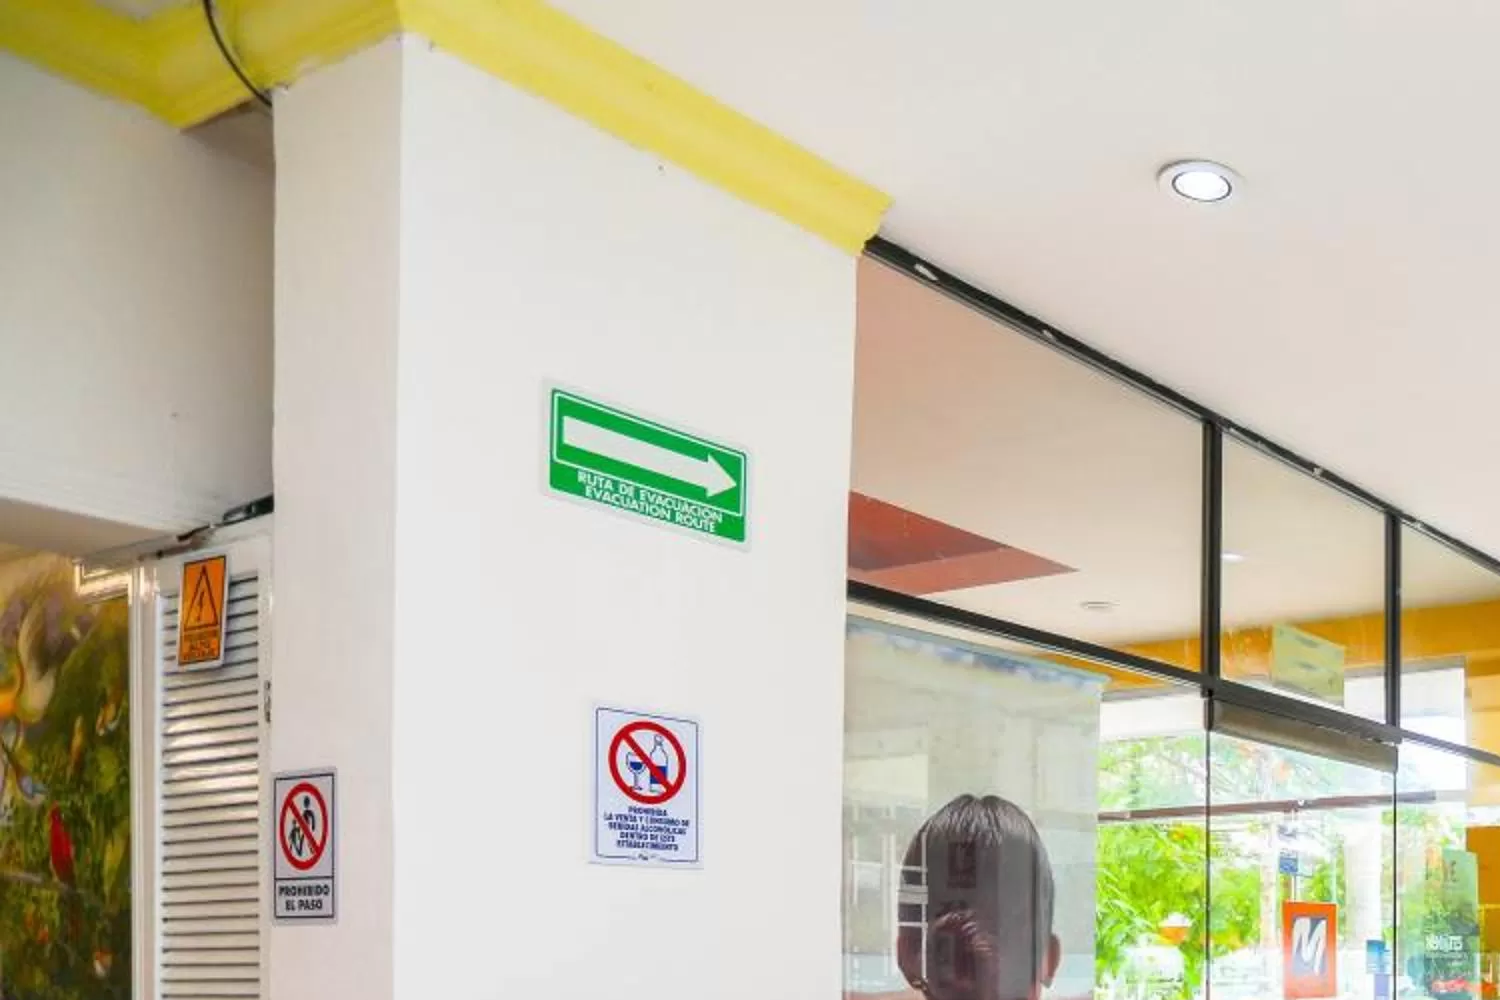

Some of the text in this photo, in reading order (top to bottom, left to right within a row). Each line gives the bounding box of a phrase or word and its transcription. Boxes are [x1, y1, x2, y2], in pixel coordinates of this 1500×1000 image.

[577, 469, 613, 491] RUTA
[619, 482, 635, 496] DE
[585, 485, 716, 532] EVACUATION ROUTE
[298, 899, 323, 911] PASO
